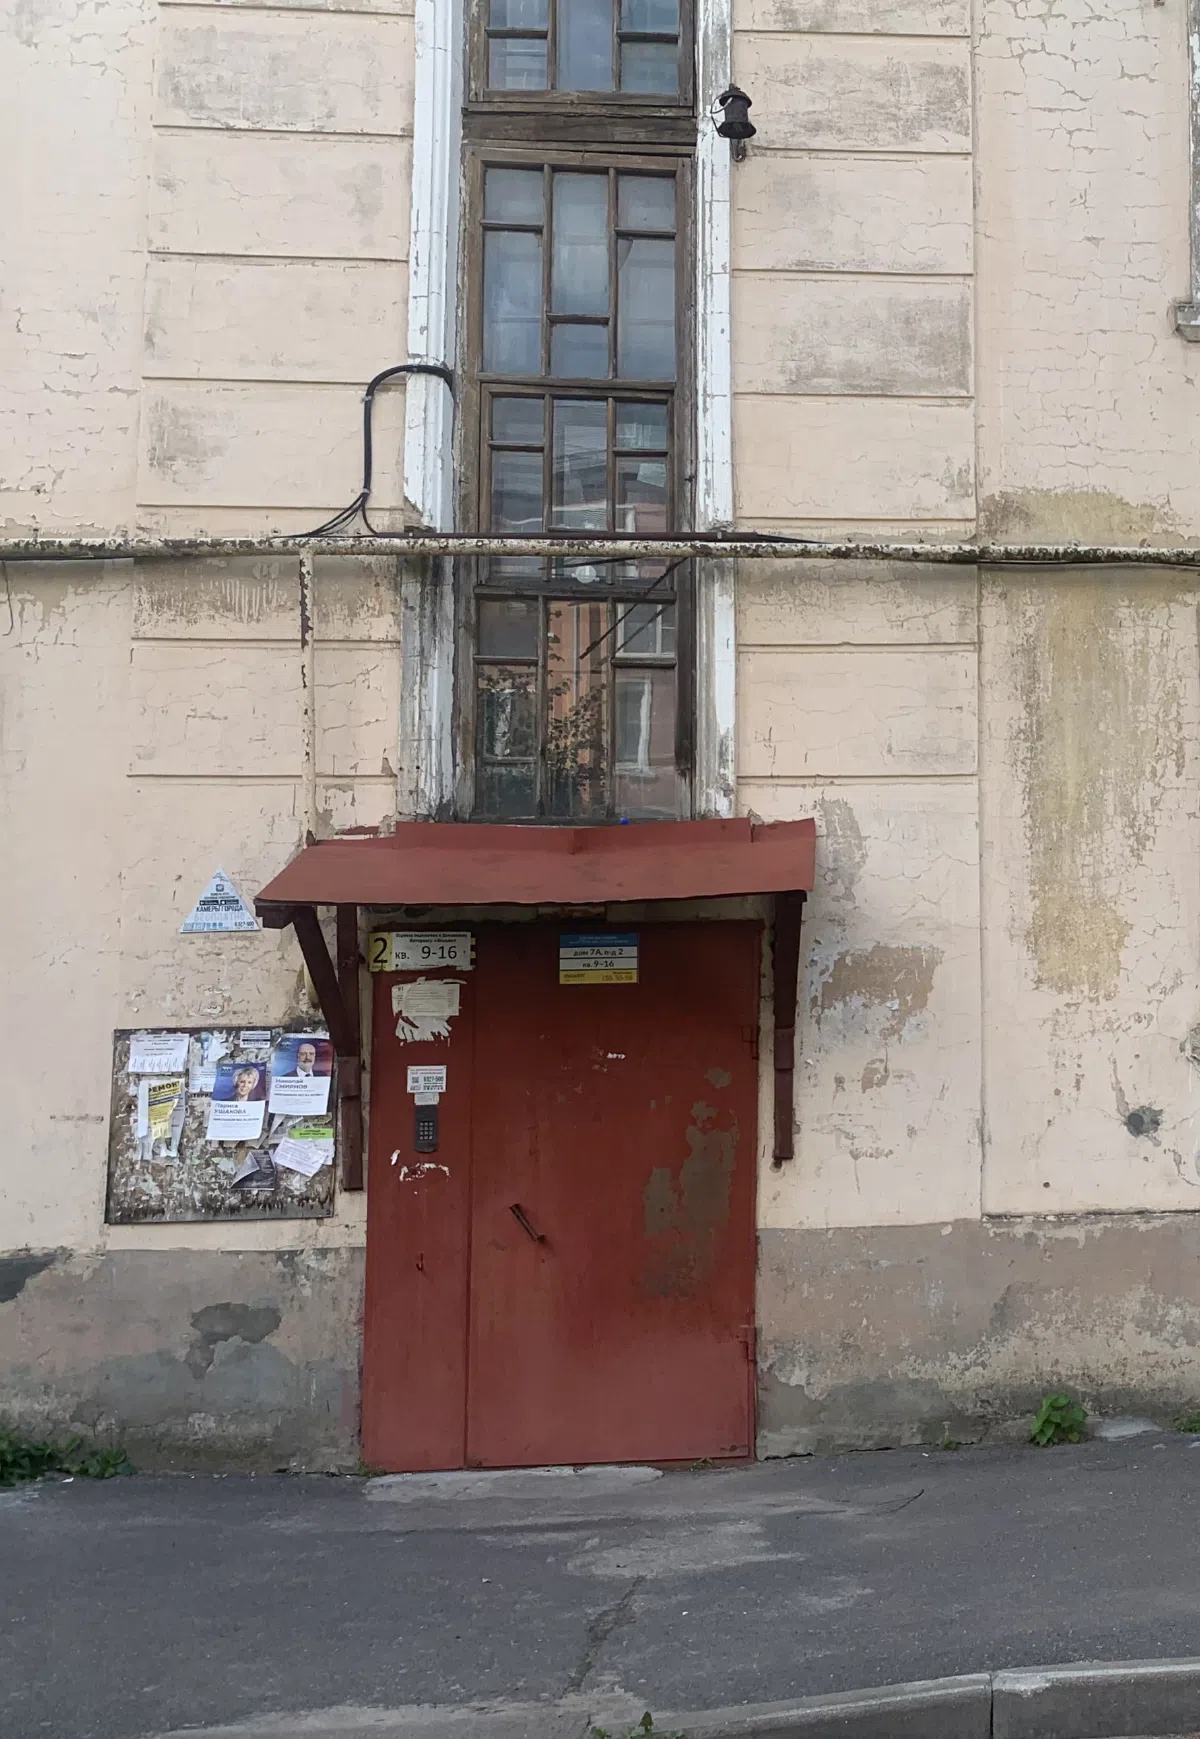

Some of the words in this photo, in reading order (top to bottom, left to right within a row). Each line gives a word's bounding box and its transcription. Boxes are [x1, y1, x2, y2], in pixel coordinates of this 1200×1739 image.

[372, 937, 388, 964] 2
[421, 945, 458, 960] 9-16
[618, 948, 624, 956] 2
[593, 960, 615, 968] 9-16
